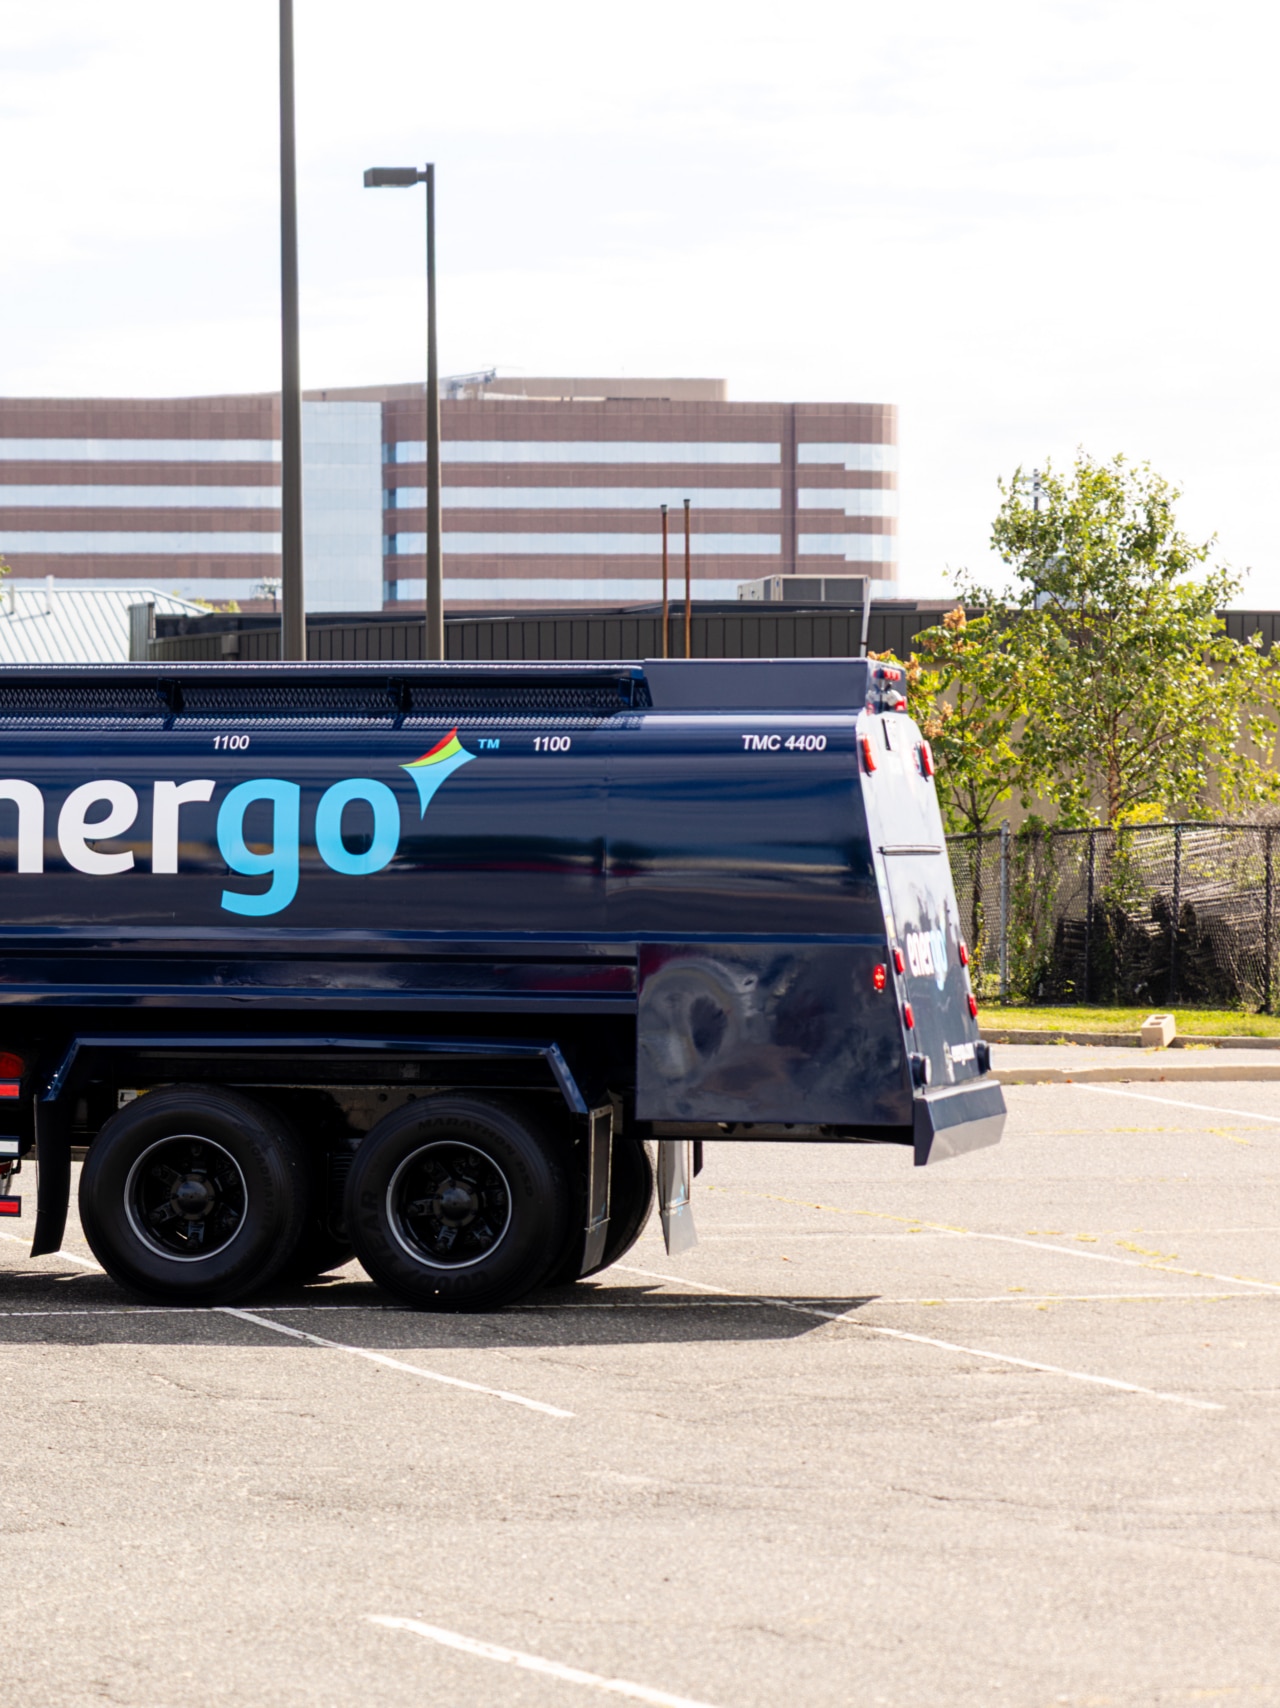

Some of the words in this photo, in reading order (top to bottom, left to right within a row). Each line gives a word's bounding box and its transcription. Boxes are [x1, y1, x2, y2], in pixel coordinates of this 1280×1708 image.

[212, 735, 250, 750] 1100
[533, 736, 571, 751] 1100
[741, 735, 781, 750] TMC
[784, 735, 827, 751] 4400
[417, 1117, 517, 1156] MARATHON
